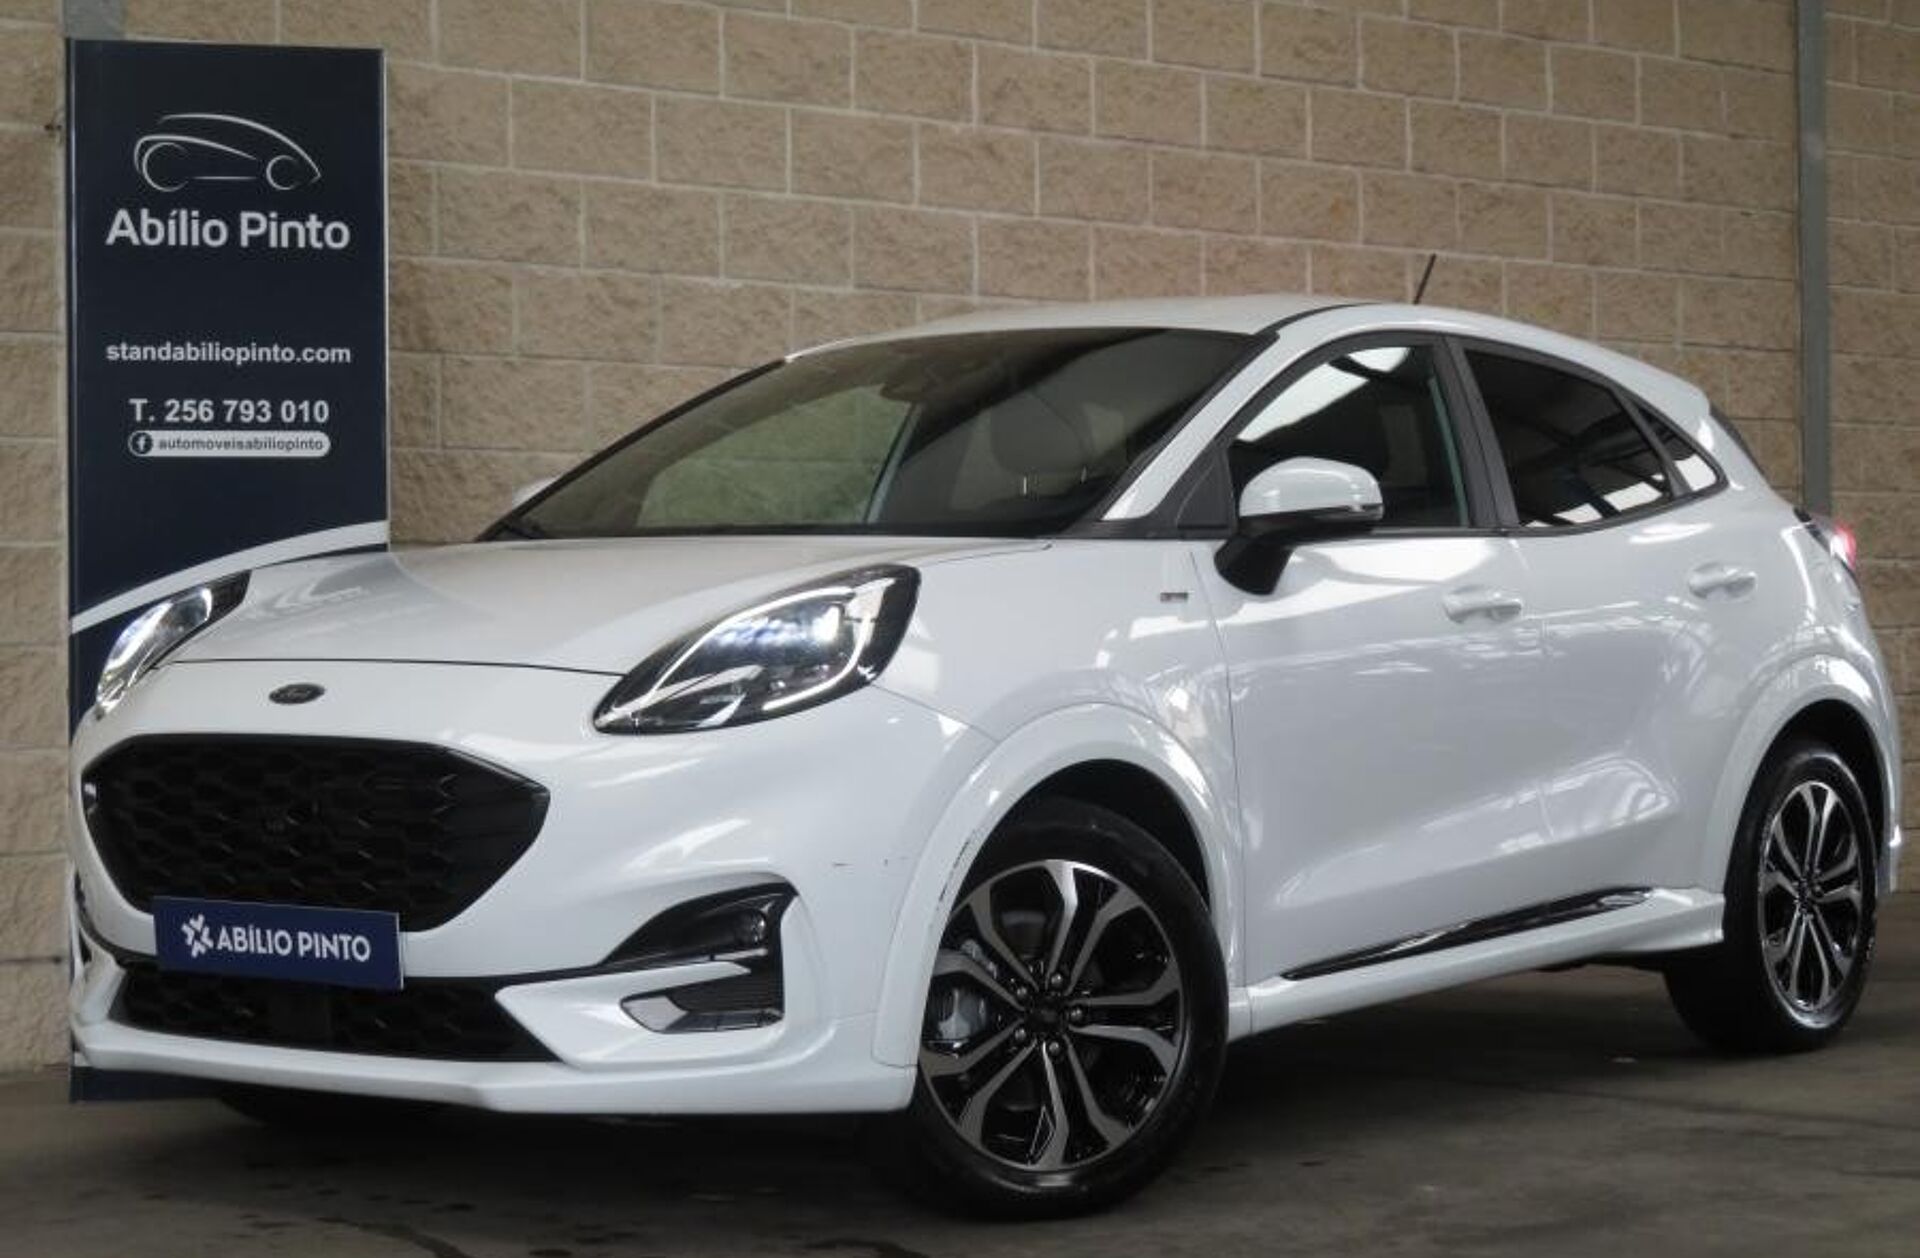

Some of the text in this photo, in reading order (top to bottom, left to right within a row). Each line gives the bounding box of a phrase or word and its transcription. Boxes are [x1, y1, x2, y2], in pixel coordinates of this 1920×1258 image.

[106, 208, 350, 249] Abílio Pinto
[106, 342, 351, 366] standabiliopinto.com
[129, 399, 329, 423] T. 256 793 010
[159, 436, 323, 453] automoveisabiliopinto
[217, 924, 372, 962] ABÍLIO PINTO
